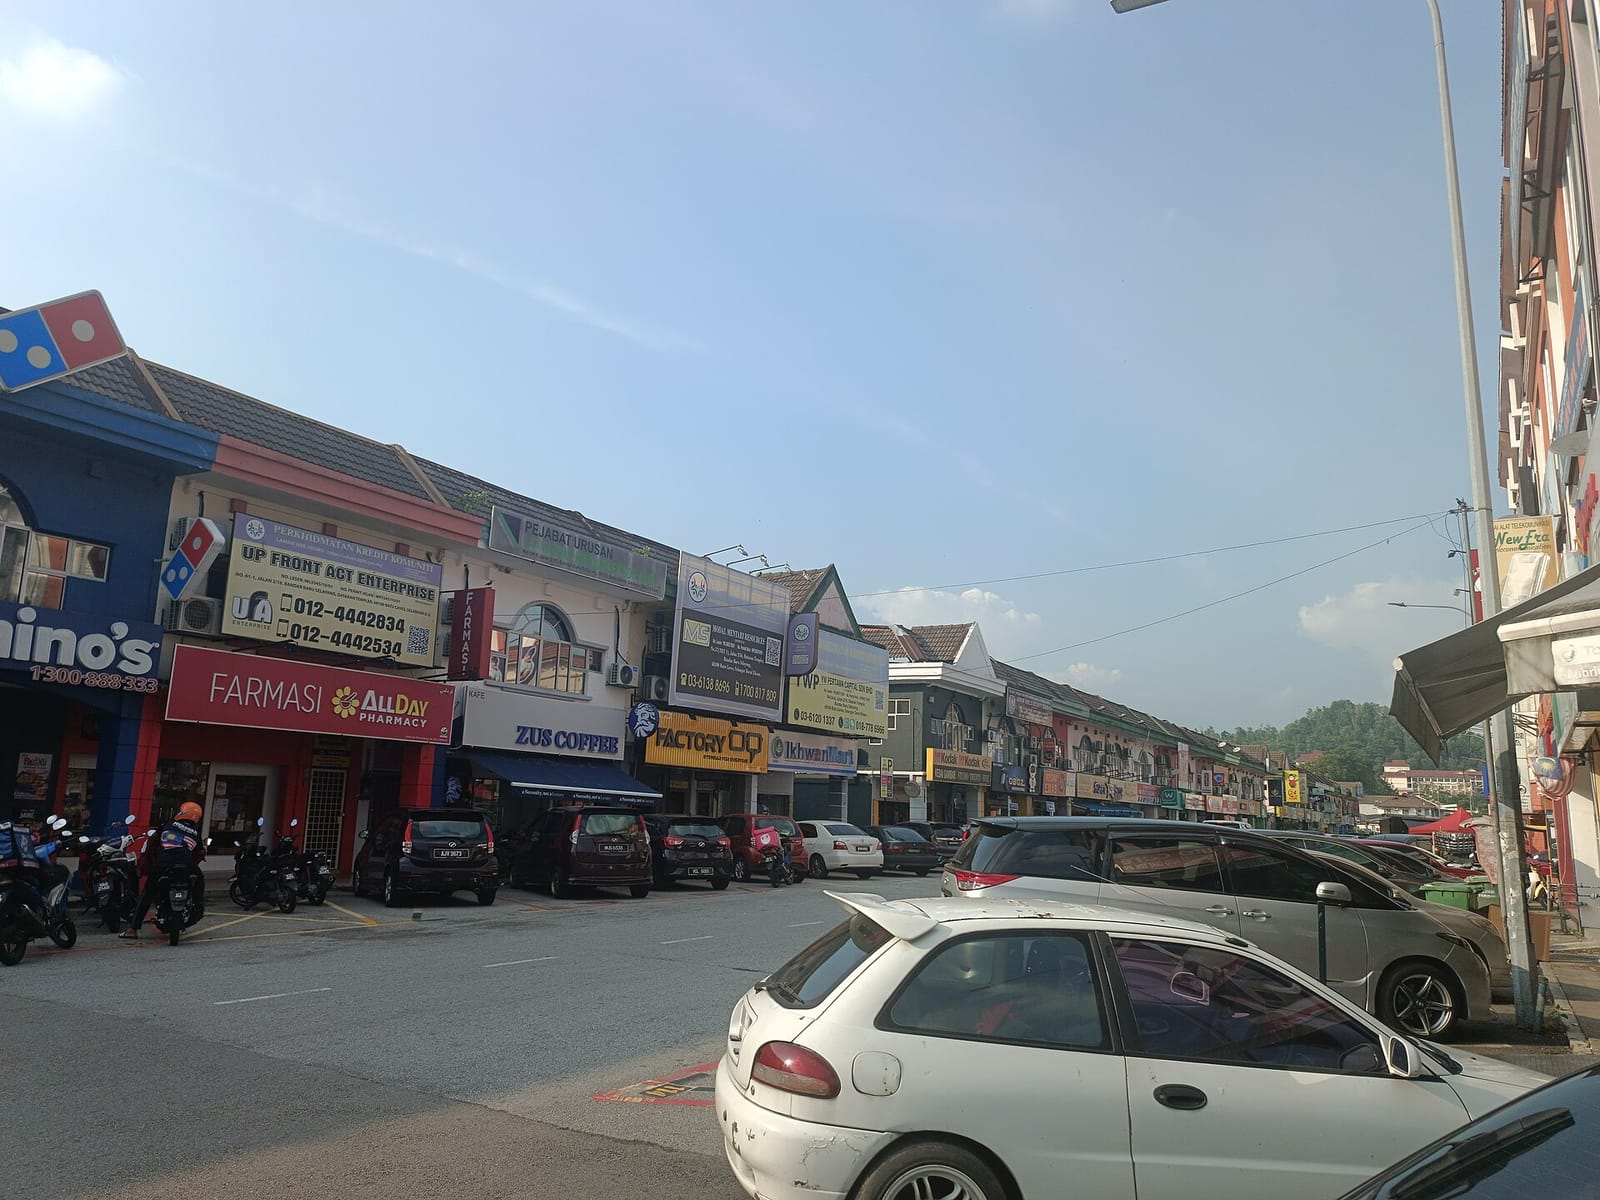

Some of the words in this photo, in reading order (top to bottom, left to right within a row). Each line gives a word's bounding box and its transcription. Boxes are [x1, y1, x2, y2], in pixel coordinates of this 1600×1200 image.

[273, 524, 355, 553] PERKHIDMATAN
[356, 543, 389, 561] KREDIT
[525, 521, 572, 546] PEJABAT
[574, 536, 614, 560] URUSAN
[1495, 532, 1523, 546] New
[1519, 529, 1550, 550] Era
[242, 544, 267, 563] UP
[270, 551, 322, 576] FRONT
[325, 563, 354, 584] ACT
[356, 571, 436, 602] ENTERPRISE
[232, 619, 272, 631] ENTERPRISE
[294, 597, 406, 634] 012-4442834
[0, 606, 154, 675] ino's
[290, 623, 402, 658] 012-4442534
[460, 591, 474, 676] FARMASI
[683, 620, 710, 645] MS
[209, 672, 323, 714] FARMASI
[468, 690, 486, 701] KAFE
[688, 674, 714, 691] 03-6138
[714, 679, 730, 693] 8696
[740, 683, 754, 698] 1700
[754, 685, 766, 700] 817
[766, 689, 777, 702] 809
[359, 712, 428, 728] PHARMACY
[800, 711, 822, 724] 03-6120
[823, 714, 835, 725] 1337
[515, 725, 554, 748] ZUS
[554, 729, 619, 754] COFFEE
[656, 728, 727, 753] FACTORY
